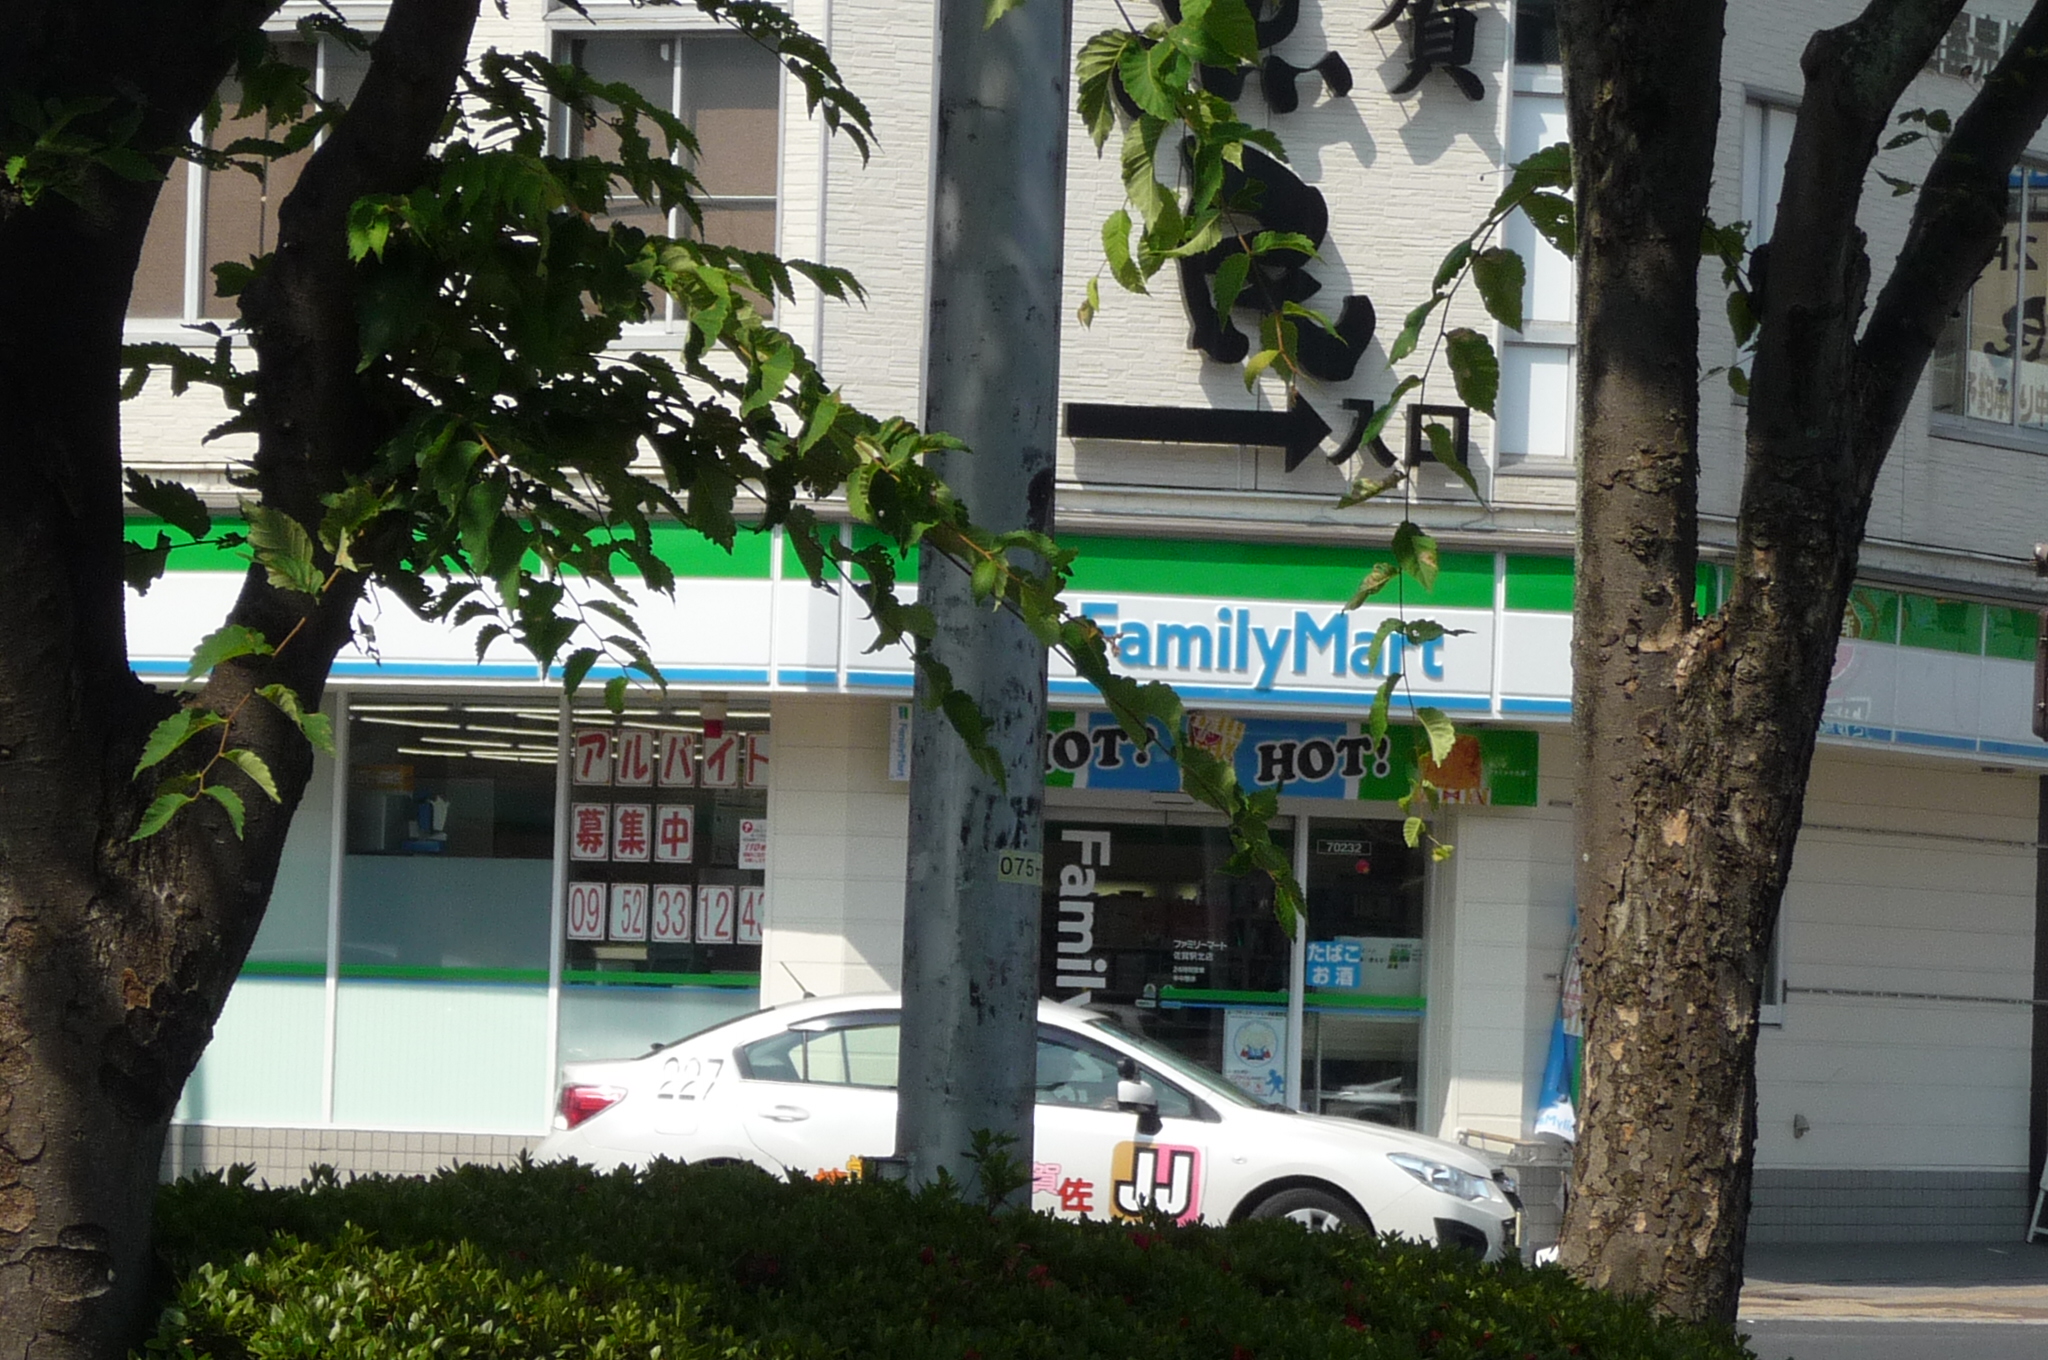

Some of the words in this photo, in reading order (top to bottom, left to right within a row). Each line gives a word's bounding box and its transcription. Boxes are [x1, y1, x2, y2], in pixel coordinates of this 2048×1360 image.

[1326, 398, 1470, 468] 入口
[1080, 602, 1444, 690] FamilyMart
[578, 733, 769, 783] アルバイト
[1043, 724, 1156, 773] OT?
[1256, 735, 1389, 783] HOT!
[576, 807, 689, 857] 募集中
[1327, 843, 1363, 854] 70232
[1307, 943, 1360, 963] たばこ
[1312, 966, 1354, 987] お酒
